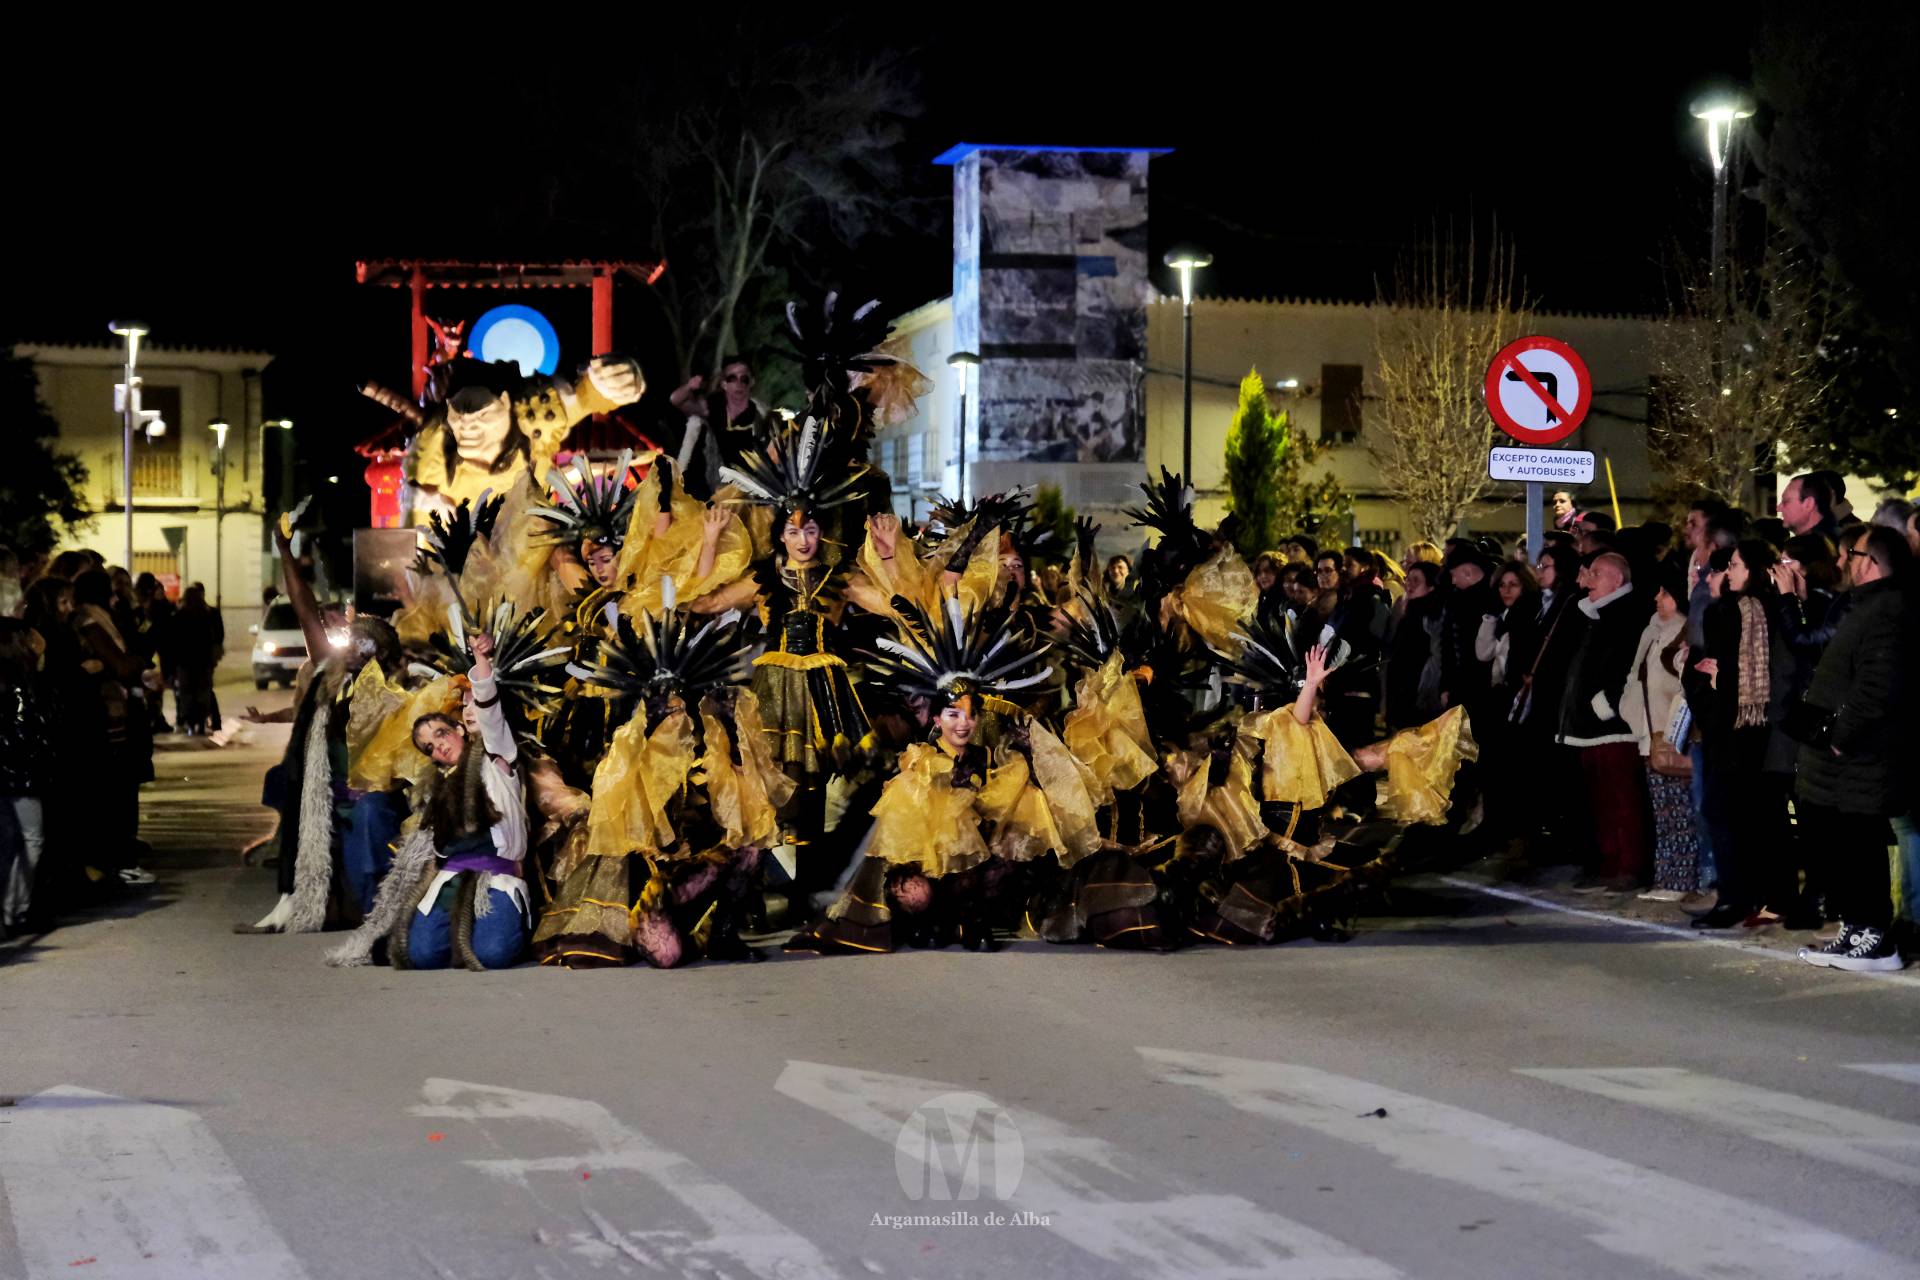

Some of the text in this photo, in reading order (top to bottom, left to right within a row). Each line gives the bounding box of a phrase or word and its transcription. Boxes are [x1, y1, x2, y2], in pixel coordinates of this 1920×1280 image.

[1492, 453, 1592, 466] EXCEPTO CAMIONES
[1508, 466, 1576, 477] Y AUTOBUSES
